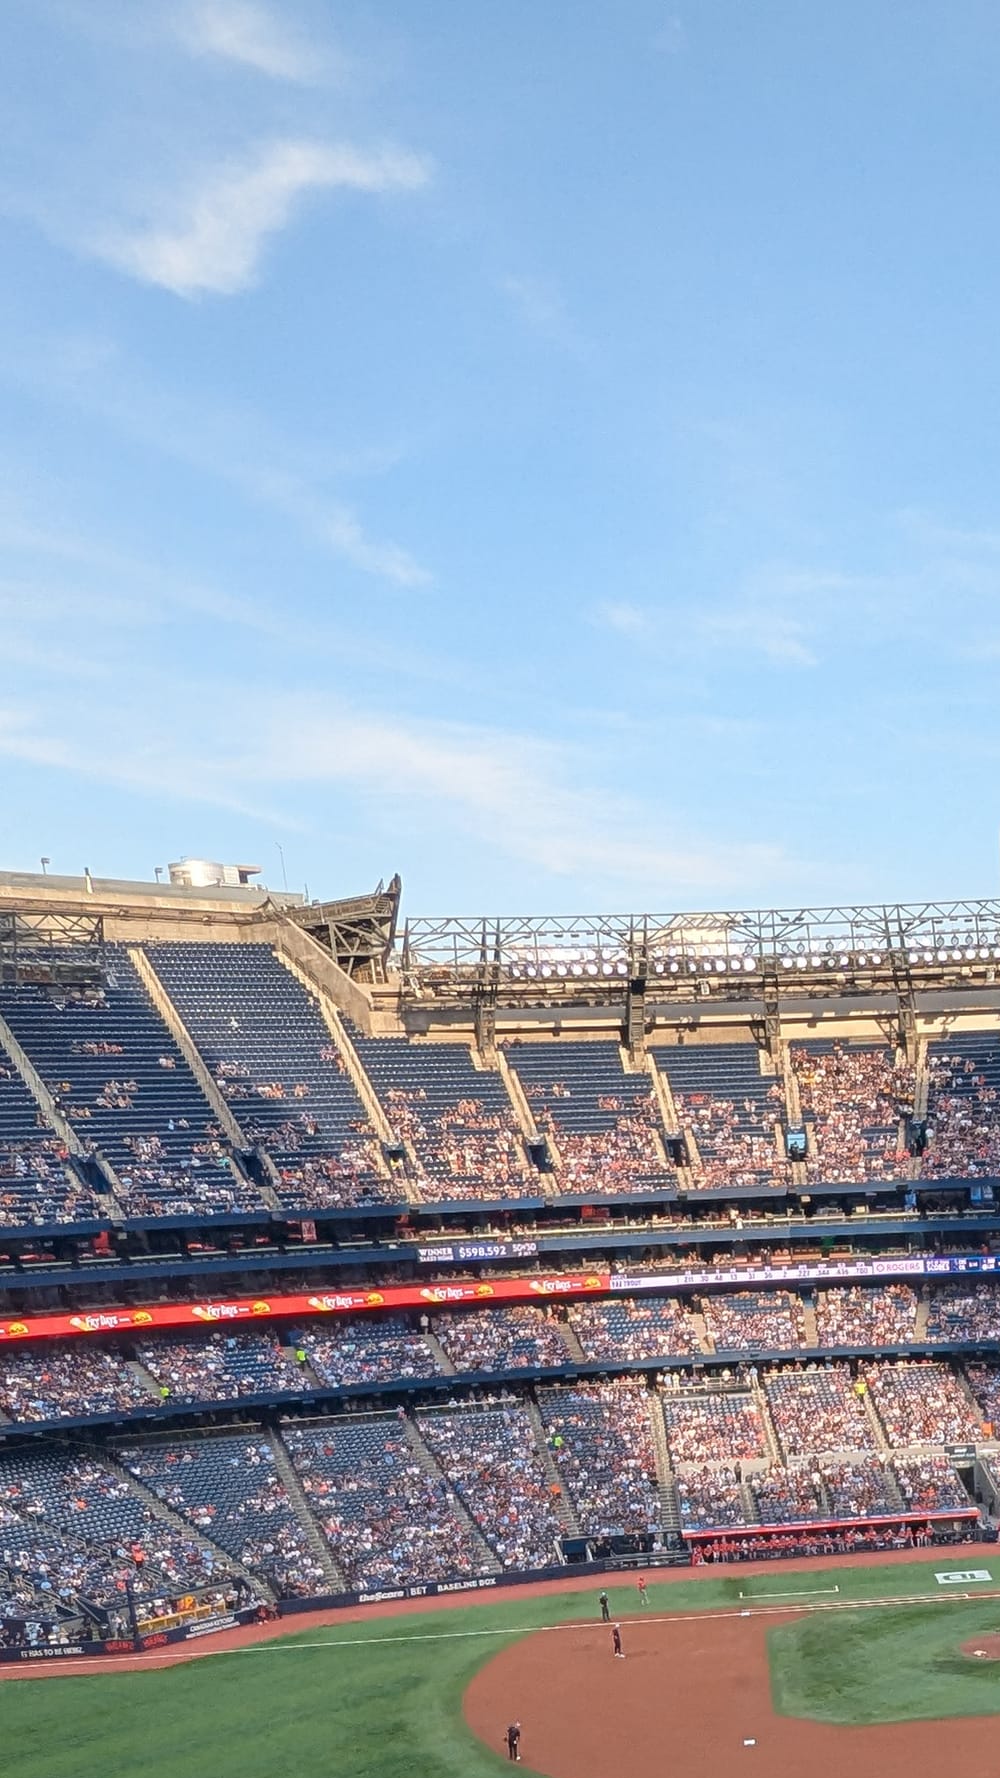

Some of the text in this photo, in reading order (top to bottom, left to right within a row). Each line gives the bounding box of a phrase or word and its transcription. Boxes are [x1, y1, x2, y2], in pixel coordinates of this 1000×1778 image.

[886, 1262, 920, 1271] ROGERS
[437, 1577, 497, 1592] BASELINE BOX
[358, 1585, 427, 1603] theScore BET
[44, 1648, 53, 1656] TO
